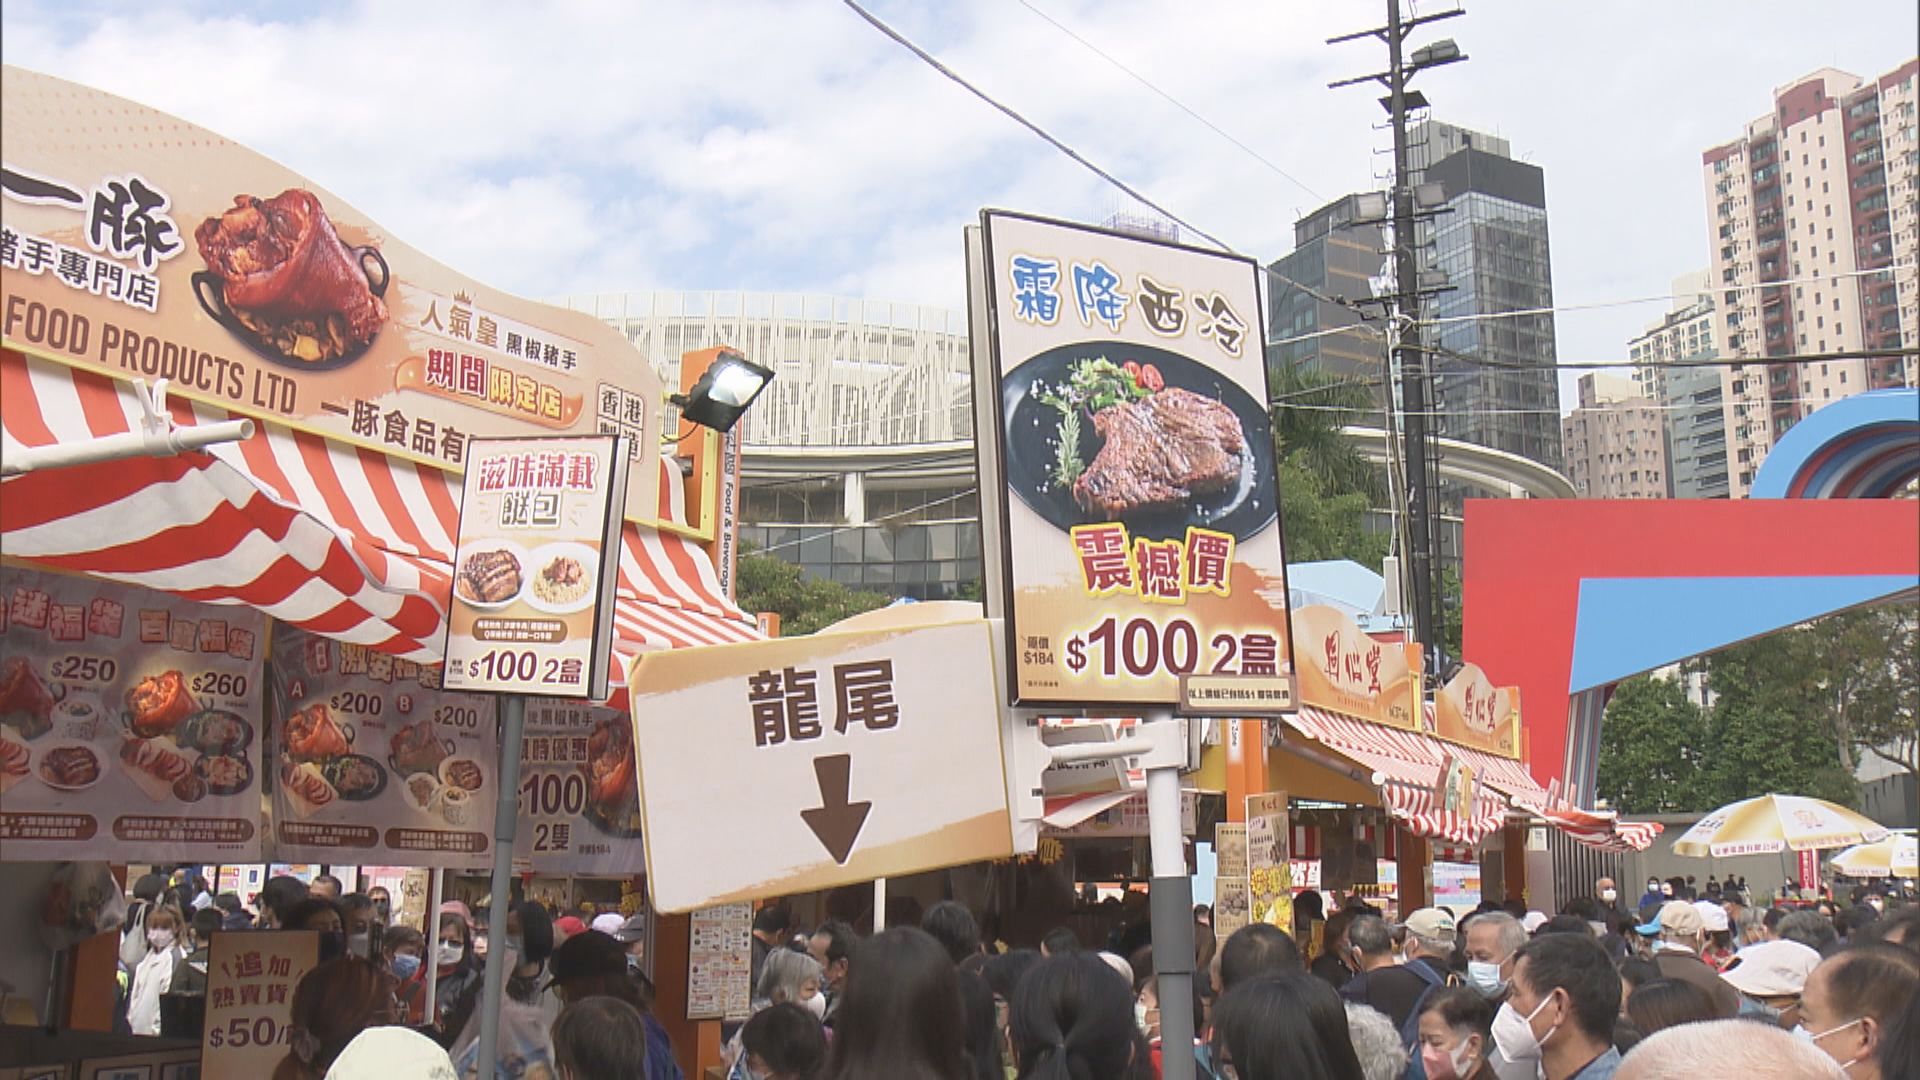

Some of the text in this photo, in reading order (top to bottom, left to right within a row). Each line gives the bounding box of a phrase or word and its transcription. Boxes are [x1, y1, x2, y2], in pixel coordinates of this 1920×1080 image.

[0, 167, 179, 267] 一豚
[1012, 257, 1244, 353] 霜降西冷
[420, 299, 579, 370] 人氣皇 黑椒豬手
[4, 294, 298, 414] FOOD PRODUCTS LTD
[426, 349, 563, 421] 期間限定店
[601, 390, 641, 424] 香港
[320, 400, 475, 463] 一豚食品有
[479, 453, 595, 491] 滋味滿載
[501, 490, 559, 525] 餸包
[725, 482, 734, 516] Food
[724, 518, 732, 528] &
[1074, 527, 1232, 597] 震撼價
[1024, 651, 1054, 665] $184
[1066, 618, 1277, 676] $100 2盒
[51, 656, 115, 681] $250
[192, 672, 247, 697] $260
[469, 650, 538, 682] $100
[541, 658, 583, 685] 2盒
[292, 684, 304, 698] A
[331, 692, 382, 716] $200
[400, 695, 410, 711] B
[748, 659, 899, 748] 龍尾
[434, 706, 478, 728] $200
[517, 774, 584, 816] 100
[534, 824, 570, 851] 2隻
[235, 952, 292, 979] 追加
